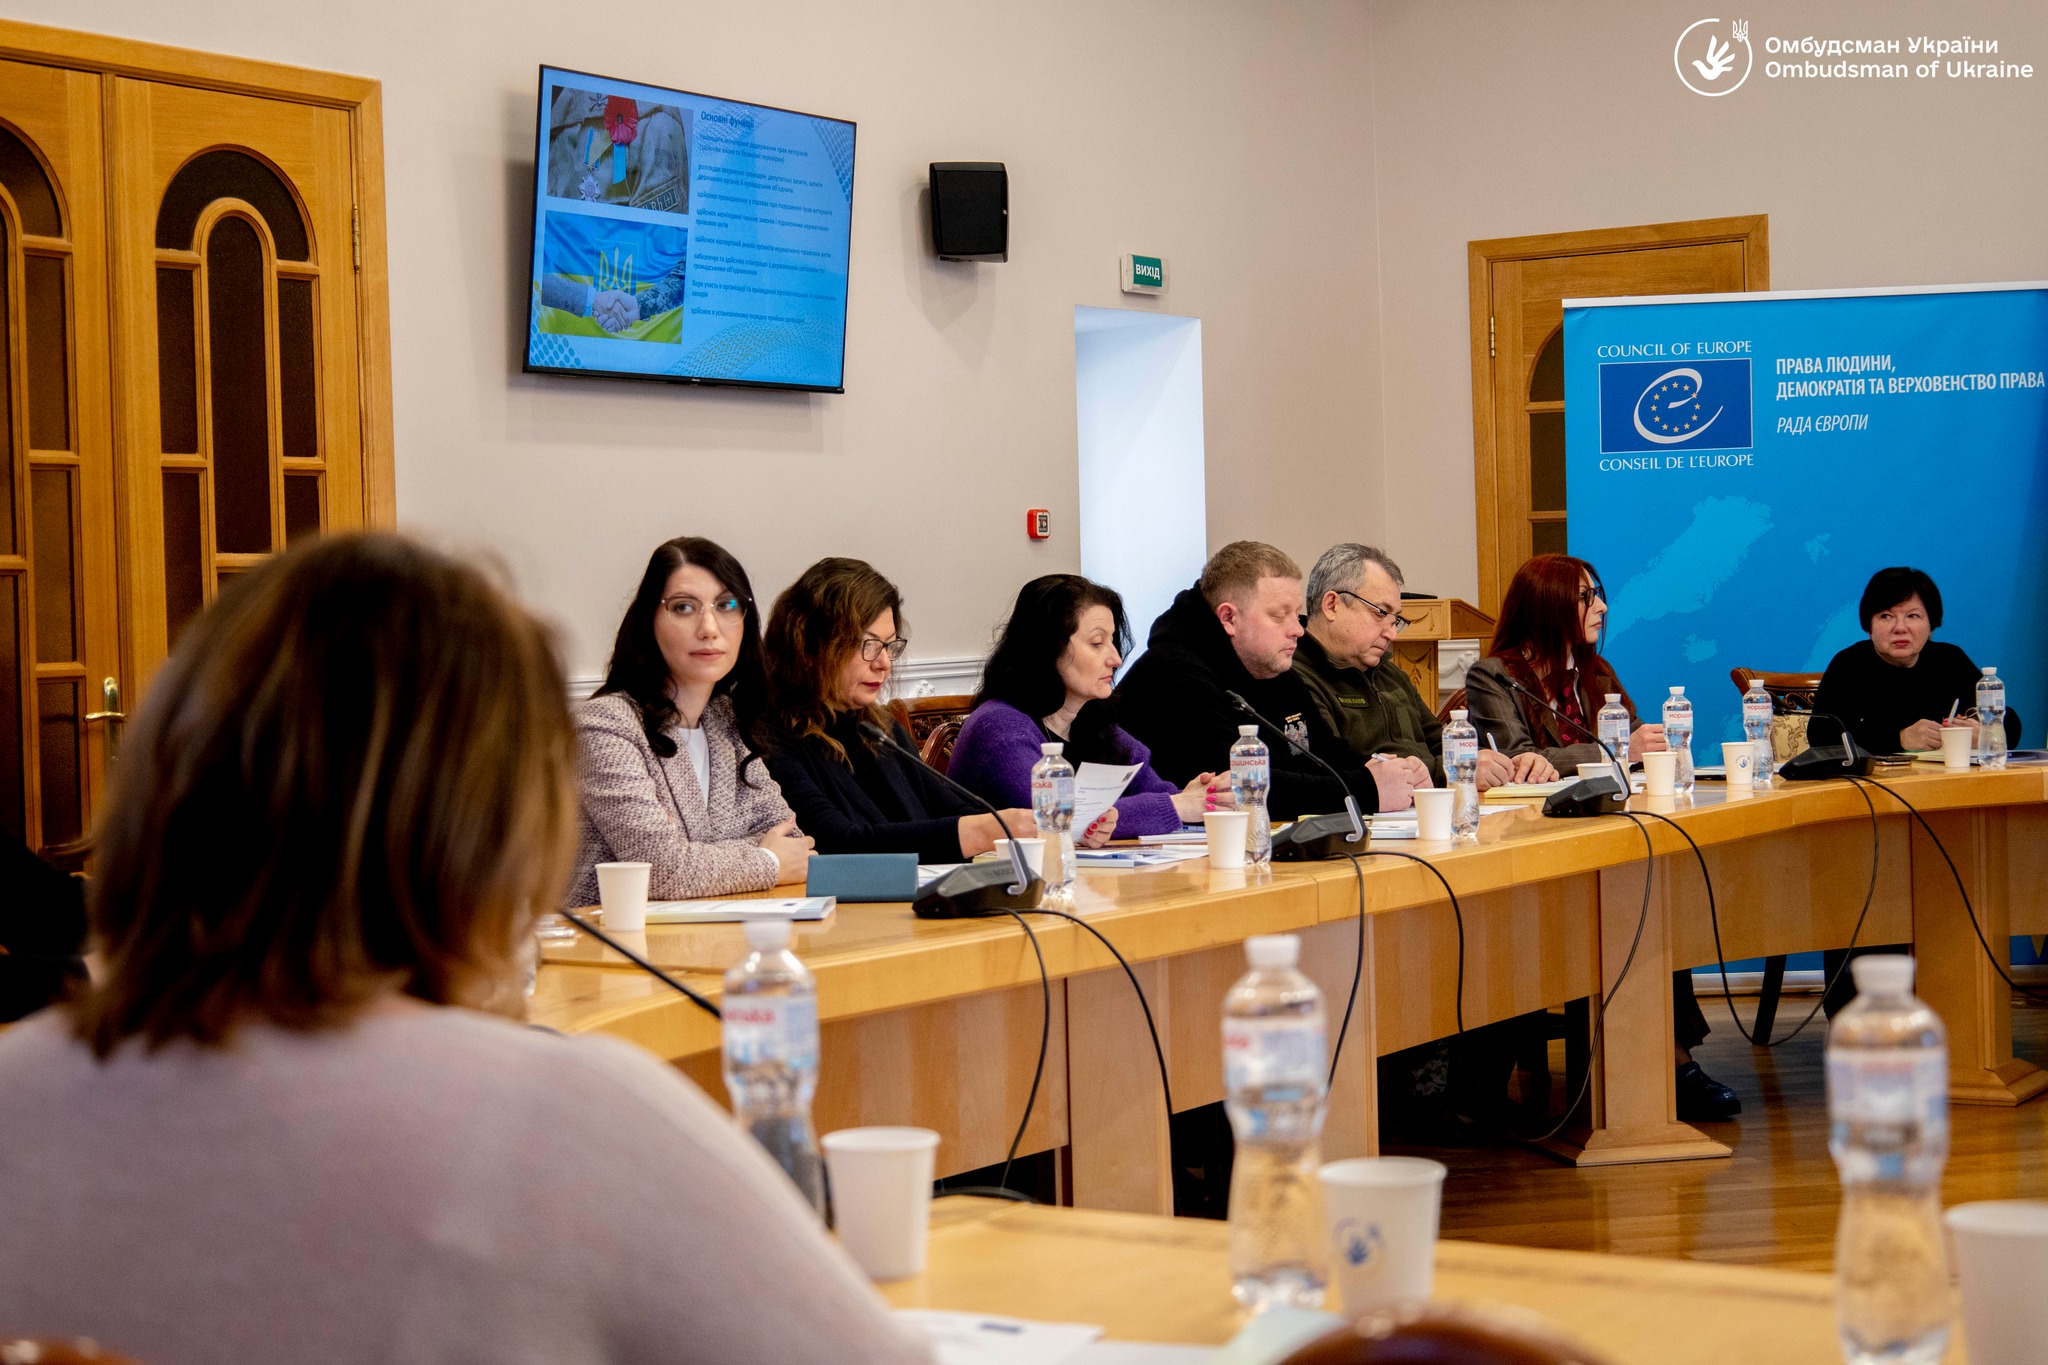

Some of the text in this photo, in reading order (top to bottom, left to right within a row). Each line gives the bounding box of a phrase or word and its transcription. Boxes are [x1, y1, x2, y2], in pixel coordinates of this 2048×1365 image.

[700, 110, 728, 125] Основні
[1135, 264, 1161, 280] ВИХІД
[1597, 340, 1752, 358] COUNCIL OF EUROPE
[1776, 354, 1896, 375] ПРАВА ЛЮДИНИ,
[1776, 371, 2046, 402] ДЕМОКРАТІЯ ТА ВЕРХОВЕНСТВО ПРАВА
[1777, 414, 1869, 436] РАДА ЄВРОПИ
[1599, 457, 1661, 472] CONSEIL
[1666, 456, 1685, 469] DE
